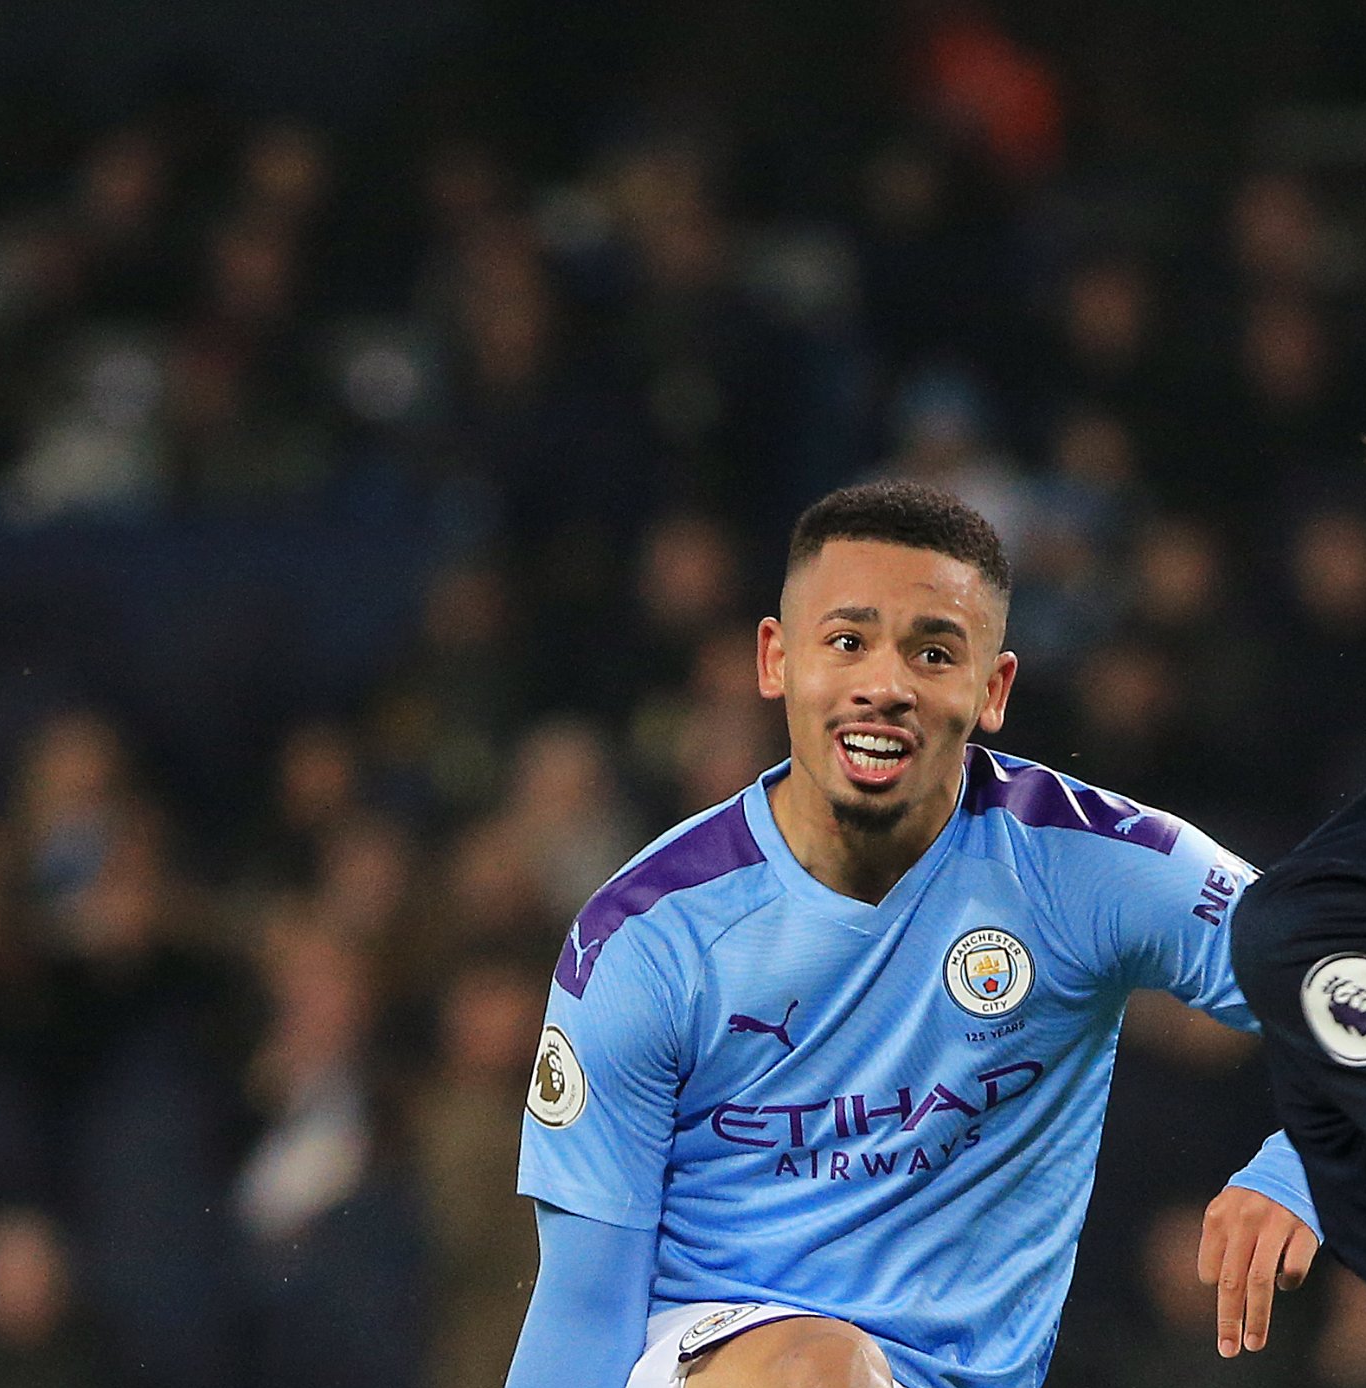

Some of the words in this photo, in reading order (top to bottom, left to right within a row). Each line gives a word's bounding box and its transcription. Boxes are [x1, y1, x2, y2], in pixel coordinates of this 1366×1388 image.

[951, 932, 1023, 967] MANCHESTER
[981, 1000, 1008, 1012] CITY
[965, 1031, 987, 1042] 125
[990, 1020, 1027, 1040] YEARS
[711, 1060, 1044, 1148] ETIHAD
[775, 1124, 982, 1182] AIRWAYS
